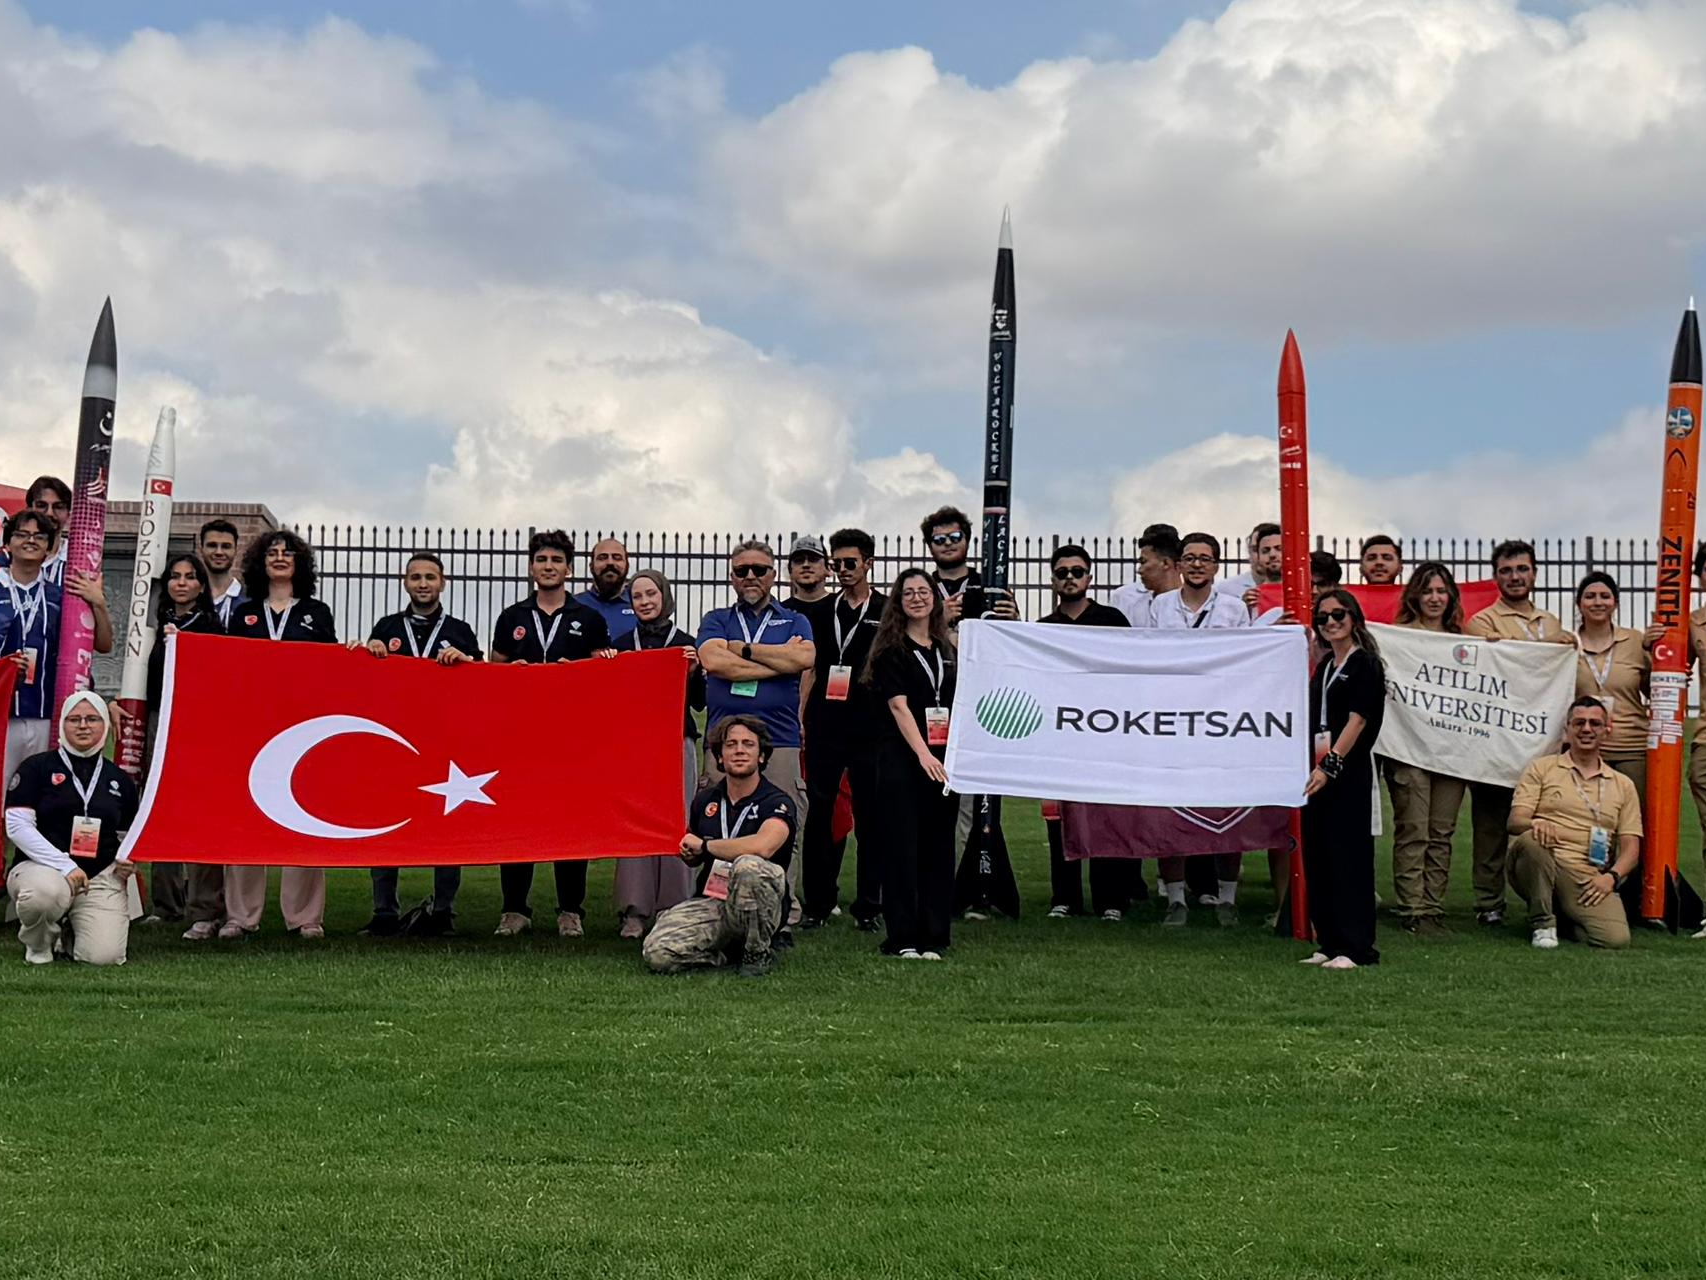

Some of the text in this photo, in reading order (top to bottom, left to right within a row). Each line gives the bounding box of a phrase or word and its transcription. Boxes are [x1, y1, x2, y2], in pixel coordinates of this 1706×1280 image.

[125, 499, 155, 658] BOZDOGAN
[1658, 535, 1683, 627] ZENITH
[1414, 663, 1509, 699] ATILIM
[1055, 706, 1293, 738] ROKETSAN
